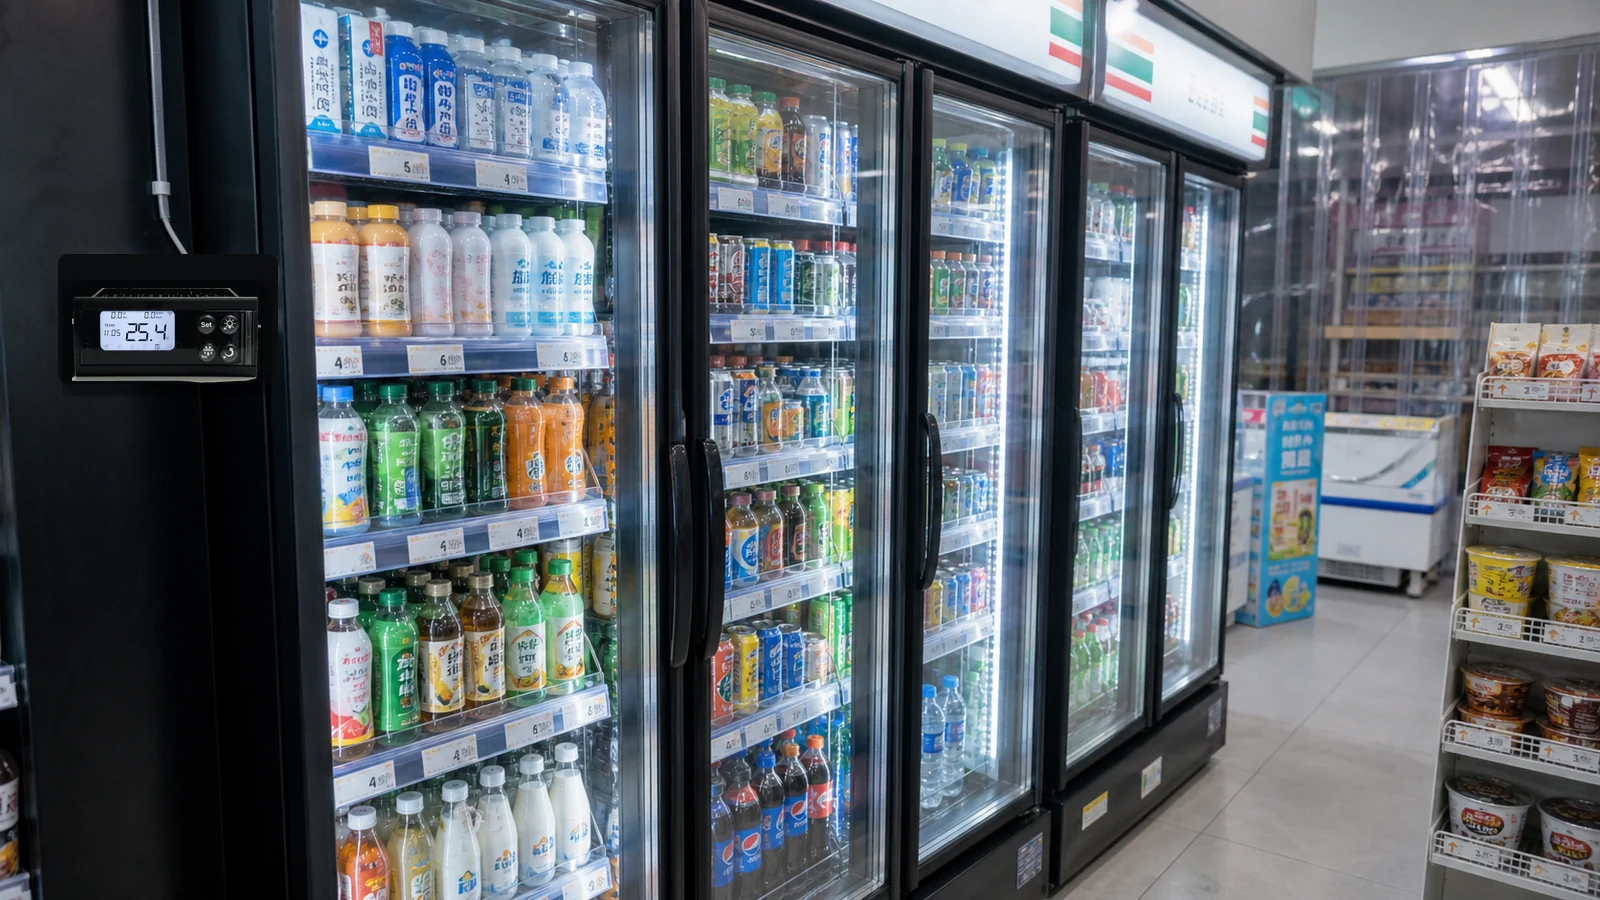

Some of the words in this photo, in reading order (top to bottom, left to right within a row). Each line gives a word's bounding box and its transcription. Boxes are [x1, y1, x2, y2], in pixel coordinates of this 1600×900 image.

[110, 311, 123, 319] 0.0
[144, 311, 156, 319] 0.0
[125, 322, 167, 342] 25.4
